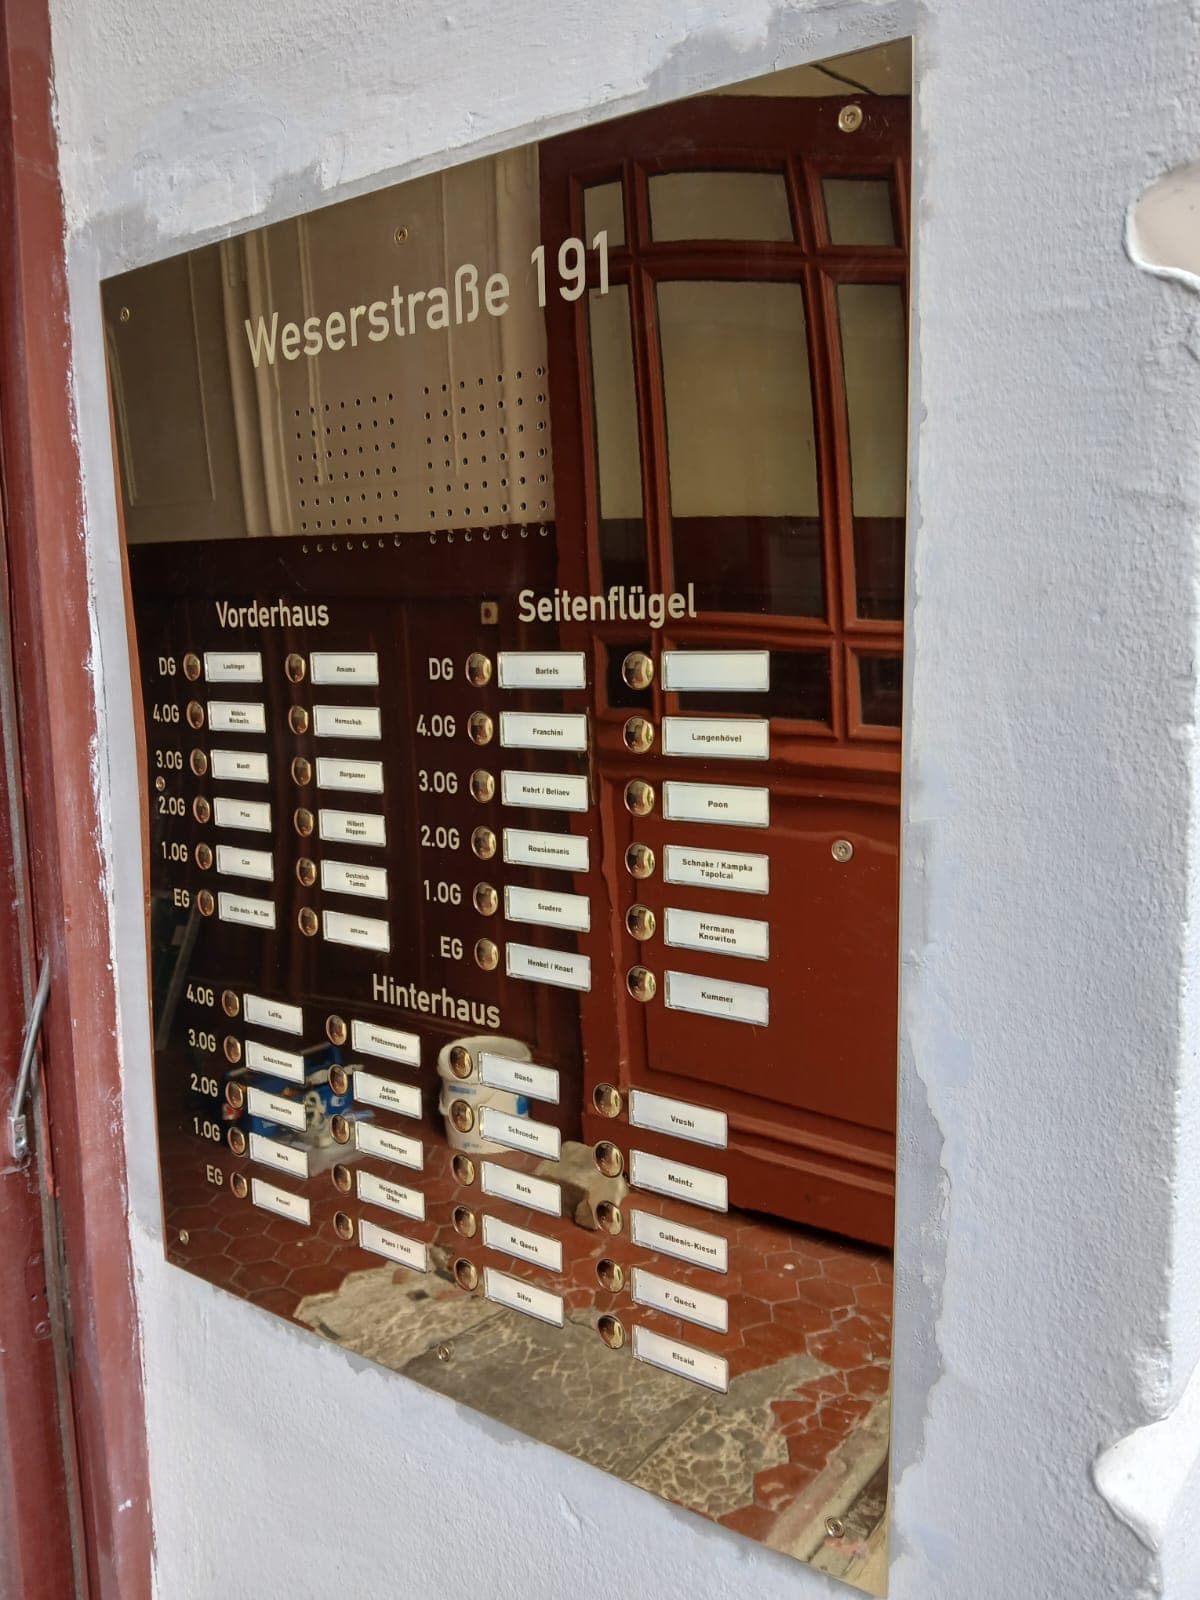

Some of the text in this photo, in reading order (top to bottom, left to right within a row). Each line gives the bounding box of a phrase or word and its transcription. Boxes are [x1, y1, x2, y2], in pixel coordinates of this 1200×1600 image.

[244, 230, 609, 369] Weserstraße 191
[517, 583, 698, 628] Seitenflügel
[215, 600, 329, 629] Vorderhaus
[159, 657, 176, 676] DG
[429, 657, 454, 681] DG
[535, 667, 559, 676] Bartels
[532, 728, 564, 737] Franchini
[691, 732, 742, 744] Langenhövel
[707, 800, 729, 809] Poon
[682, 857, 714, 869] Schnake
[721, 863, 753, 873] Kampka
[700, 869, 734, 880] Tapolcai
[173, 888, 190, 908] EG
[700, 922, 735, 935] Hermann
[440, 935, 464, 961] EG
[527, 958, 549, 970] Henkel
[372, 973, 501, 1029] Hinterhaus
[701, 991, 734, 1004] Kummer
[670, 1114, 695, 1129] Vrushi
[508, 1125, 539, 1142] Schroeder
[206, 1164, 223, 1186] EG
[668, 1173, 694, 1188] Maintz
